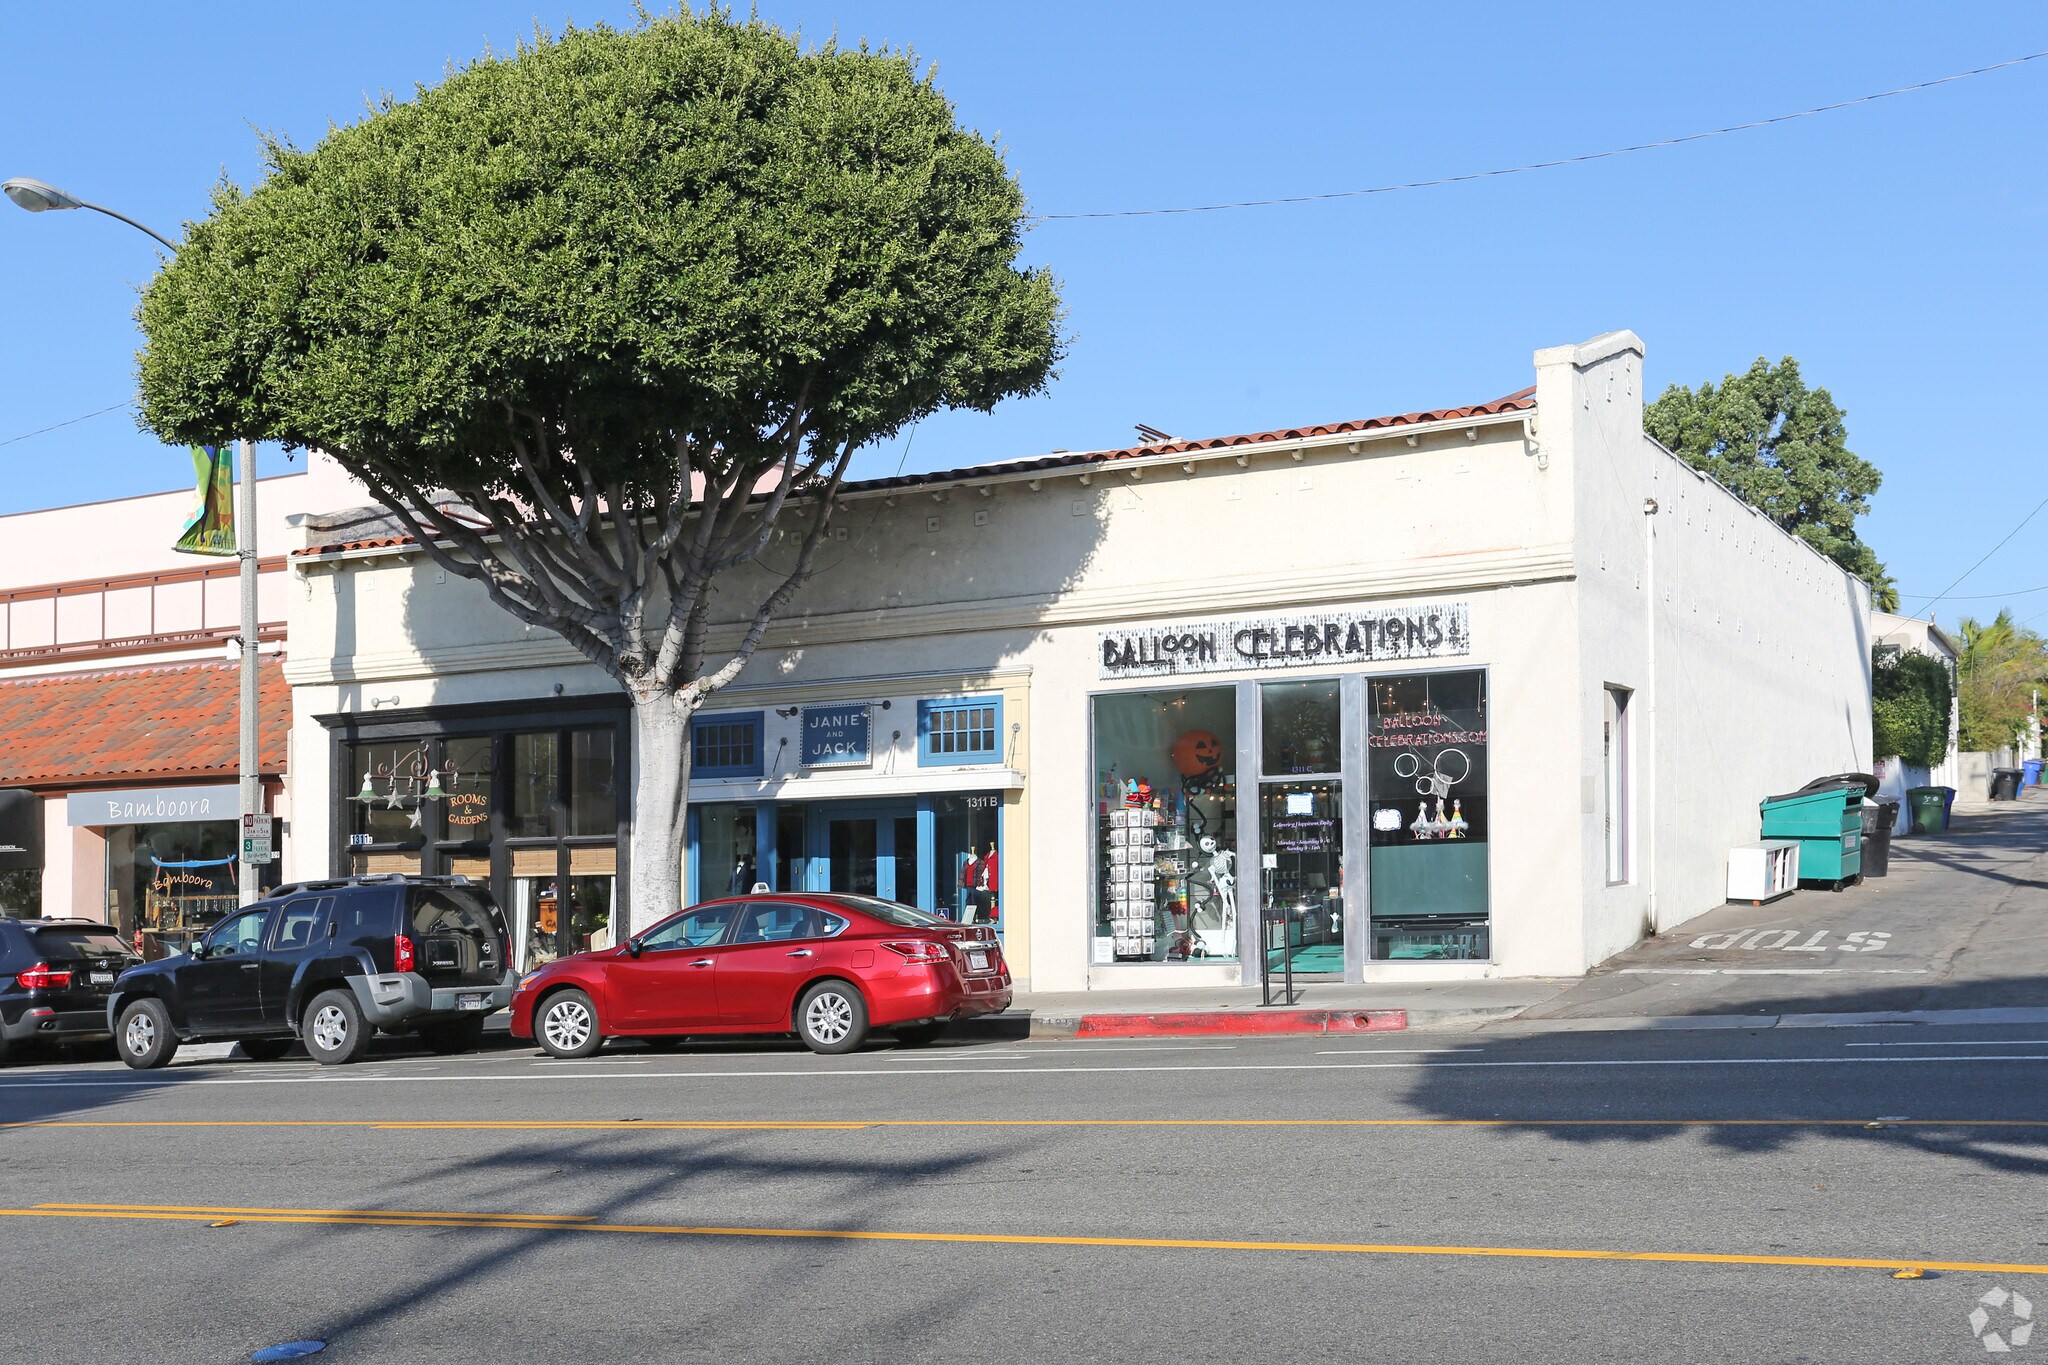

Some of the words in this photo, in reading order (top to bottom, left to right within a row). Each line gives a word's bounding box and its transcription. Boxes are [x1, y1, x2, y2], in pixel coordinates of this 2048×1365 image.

[1103, 632, 1217, 667] BALLOON
[1233, 614, 1444, 659] CELEBRATIONS
[810, 714, 860, 728] JANIE
[1383, 714, 1441, 730] BALLOON
[826, 730, 844, 738] AND
[812, 741, 857, 755] JACK
[107, 794, 210, 819] Bamboora
[450, 793, 487, 807] ROOMS
[966, 797, 987, 808] 1311
[990, 796, 998, 807] B
[464, 804, 472, 815] &
[245, 815, 253, 826] NO
[253, 816, 271, 825] PARKING
[448, 812, 488, 825] GARDENS
[245, 841, 251, 850] 3
[152, 871, 213, 890] Bamboora
[1688, 929, 1892, 952] STOP
